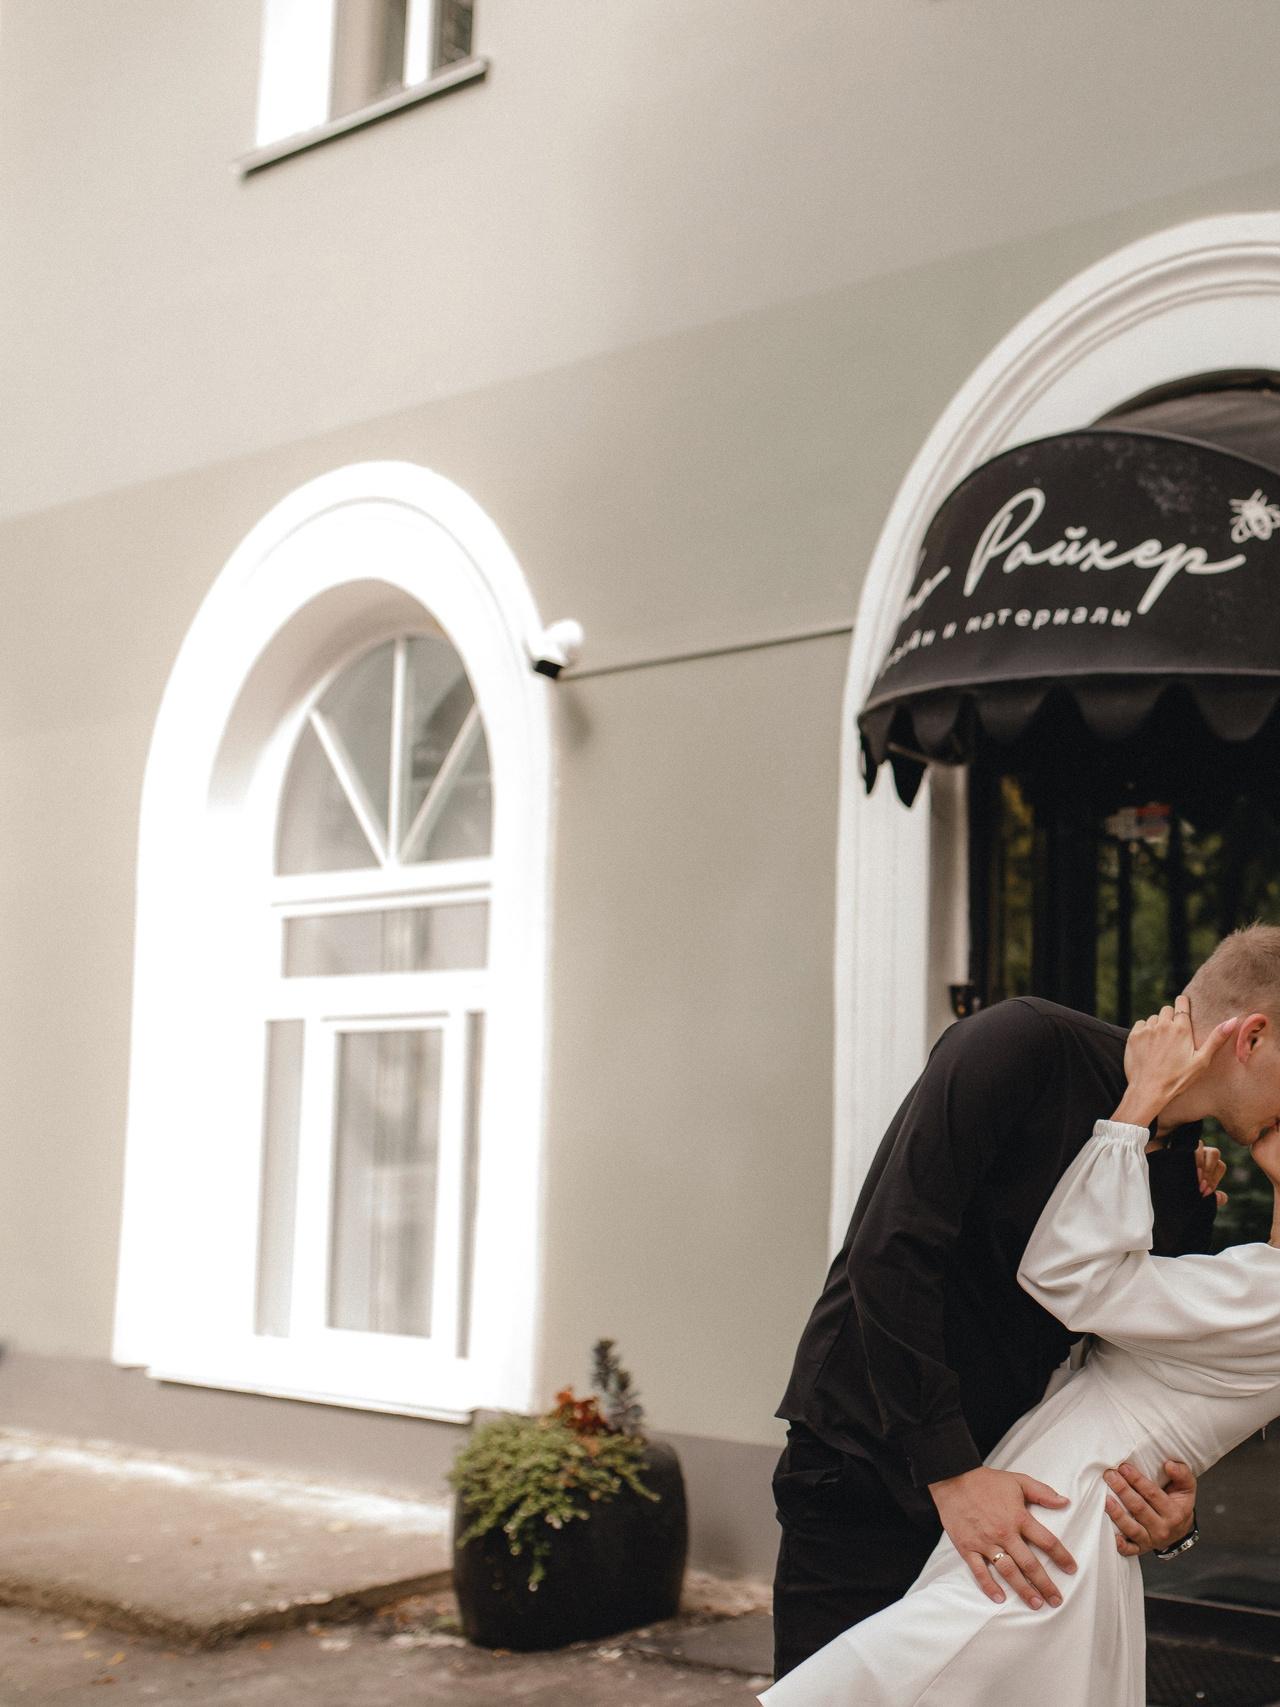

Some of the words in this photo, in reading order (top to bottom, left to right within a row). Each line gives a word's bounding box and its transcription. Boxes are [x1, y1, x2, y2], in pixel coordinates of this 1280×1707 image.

[963, 487, 1246, 615] Райхер
[942, 621, 957, 640] и
[964, 606, 1132, 634] материалы
